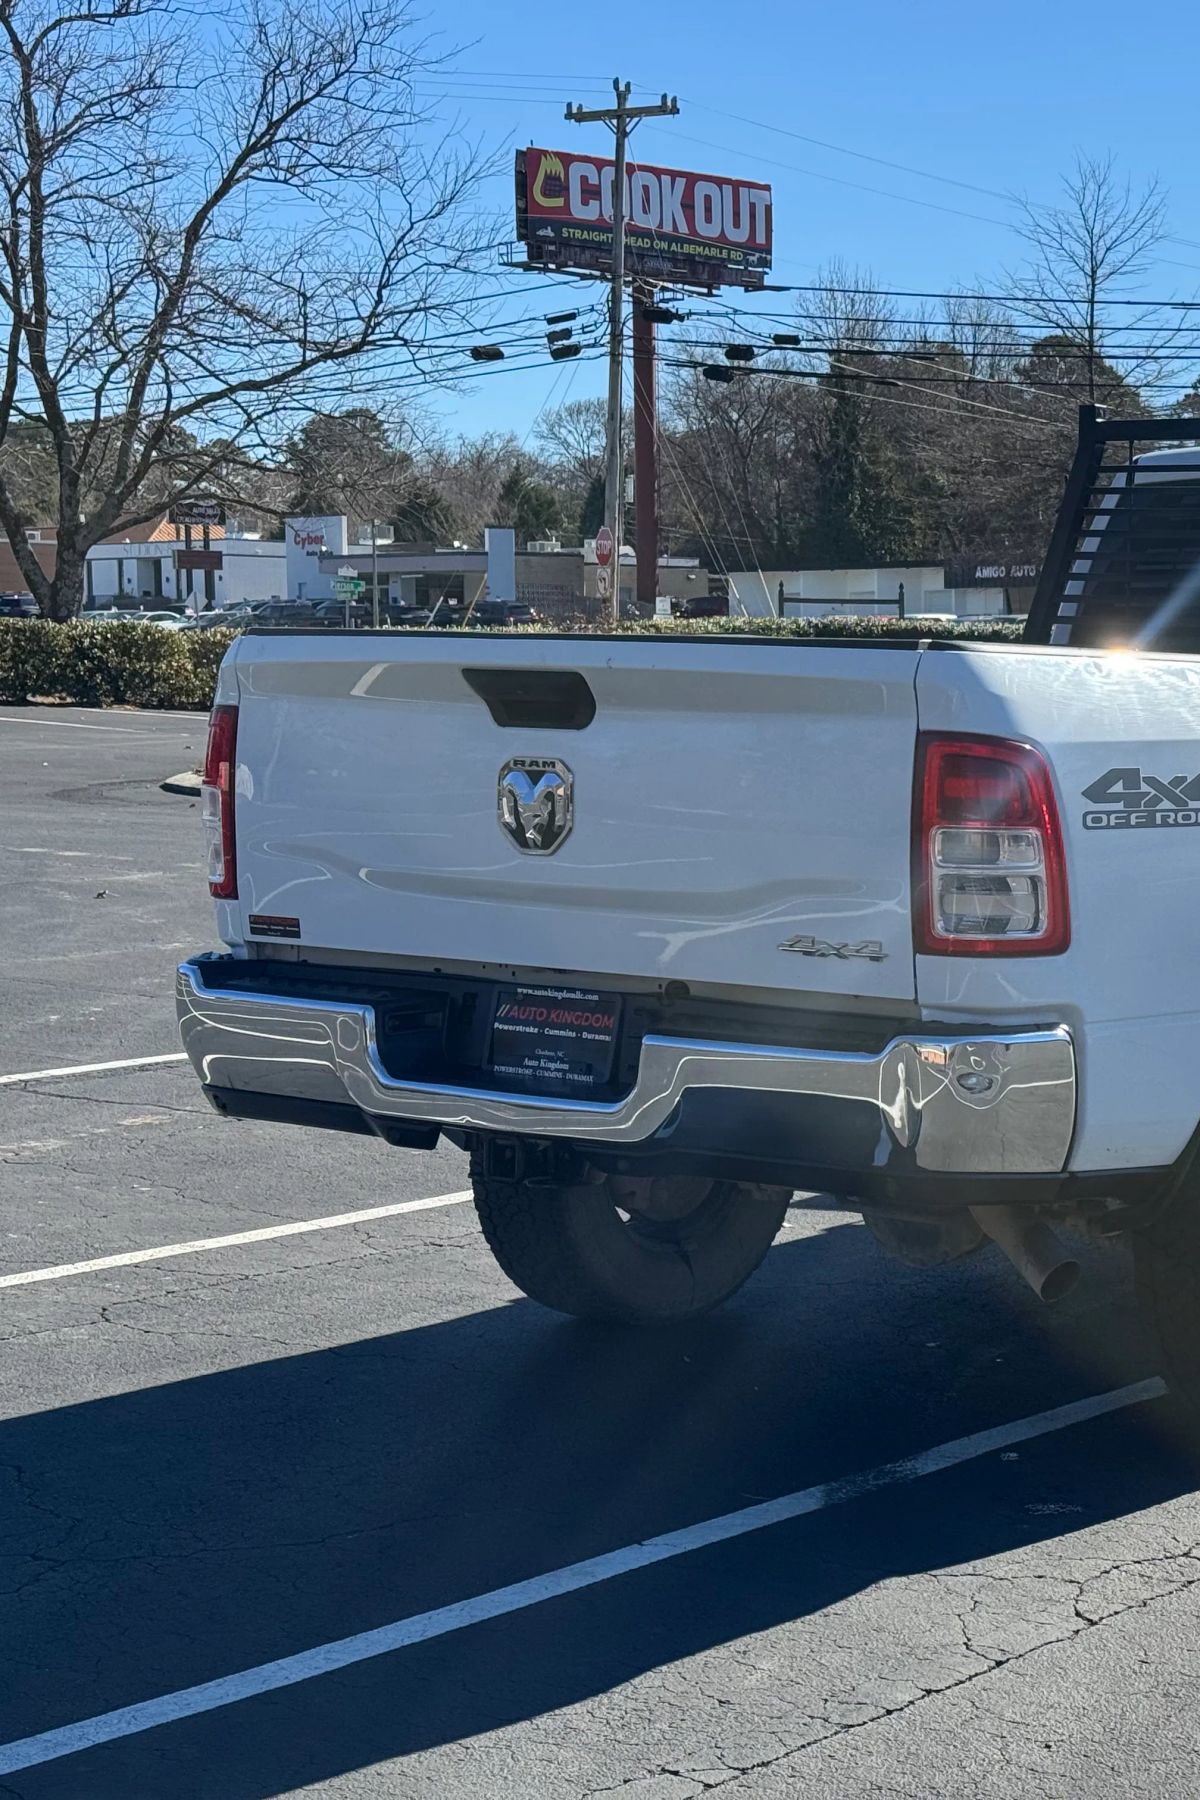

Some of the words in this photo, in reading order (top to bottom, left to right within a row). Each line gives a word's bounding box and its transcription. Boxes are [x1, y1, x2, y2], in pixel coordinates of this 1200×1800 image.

[568, 161, 688, 234] COOK
[694, 181, 770, 244] OUT
[561, 227, 613, 243] STRAIGHT
[623, 235, 651, 248] HEAD
[653, 240, 668, 250] ON
[670, 242, 728, 258] ALBEMARLE
[730, 250, 744, 260] RD
[294, 532, 325, 550] Cyber
[597, 540, 611, 554] STOP
[975, 565, 1006, 578] AMIGO
[1010, 564, 1036, 577] AUTO
[513, 760, 556, 769] RAM
[1086, 813, 1149, 827] OFF
[777, 934, 889, 962] 4x4
[549, 1009, 614, 1028] KINGDOM
[545, 1028, 575, 1038] Cummins
[523, 1057, 540, 1066] Auto
[540, 1058, 569, 1071] Kingdom
